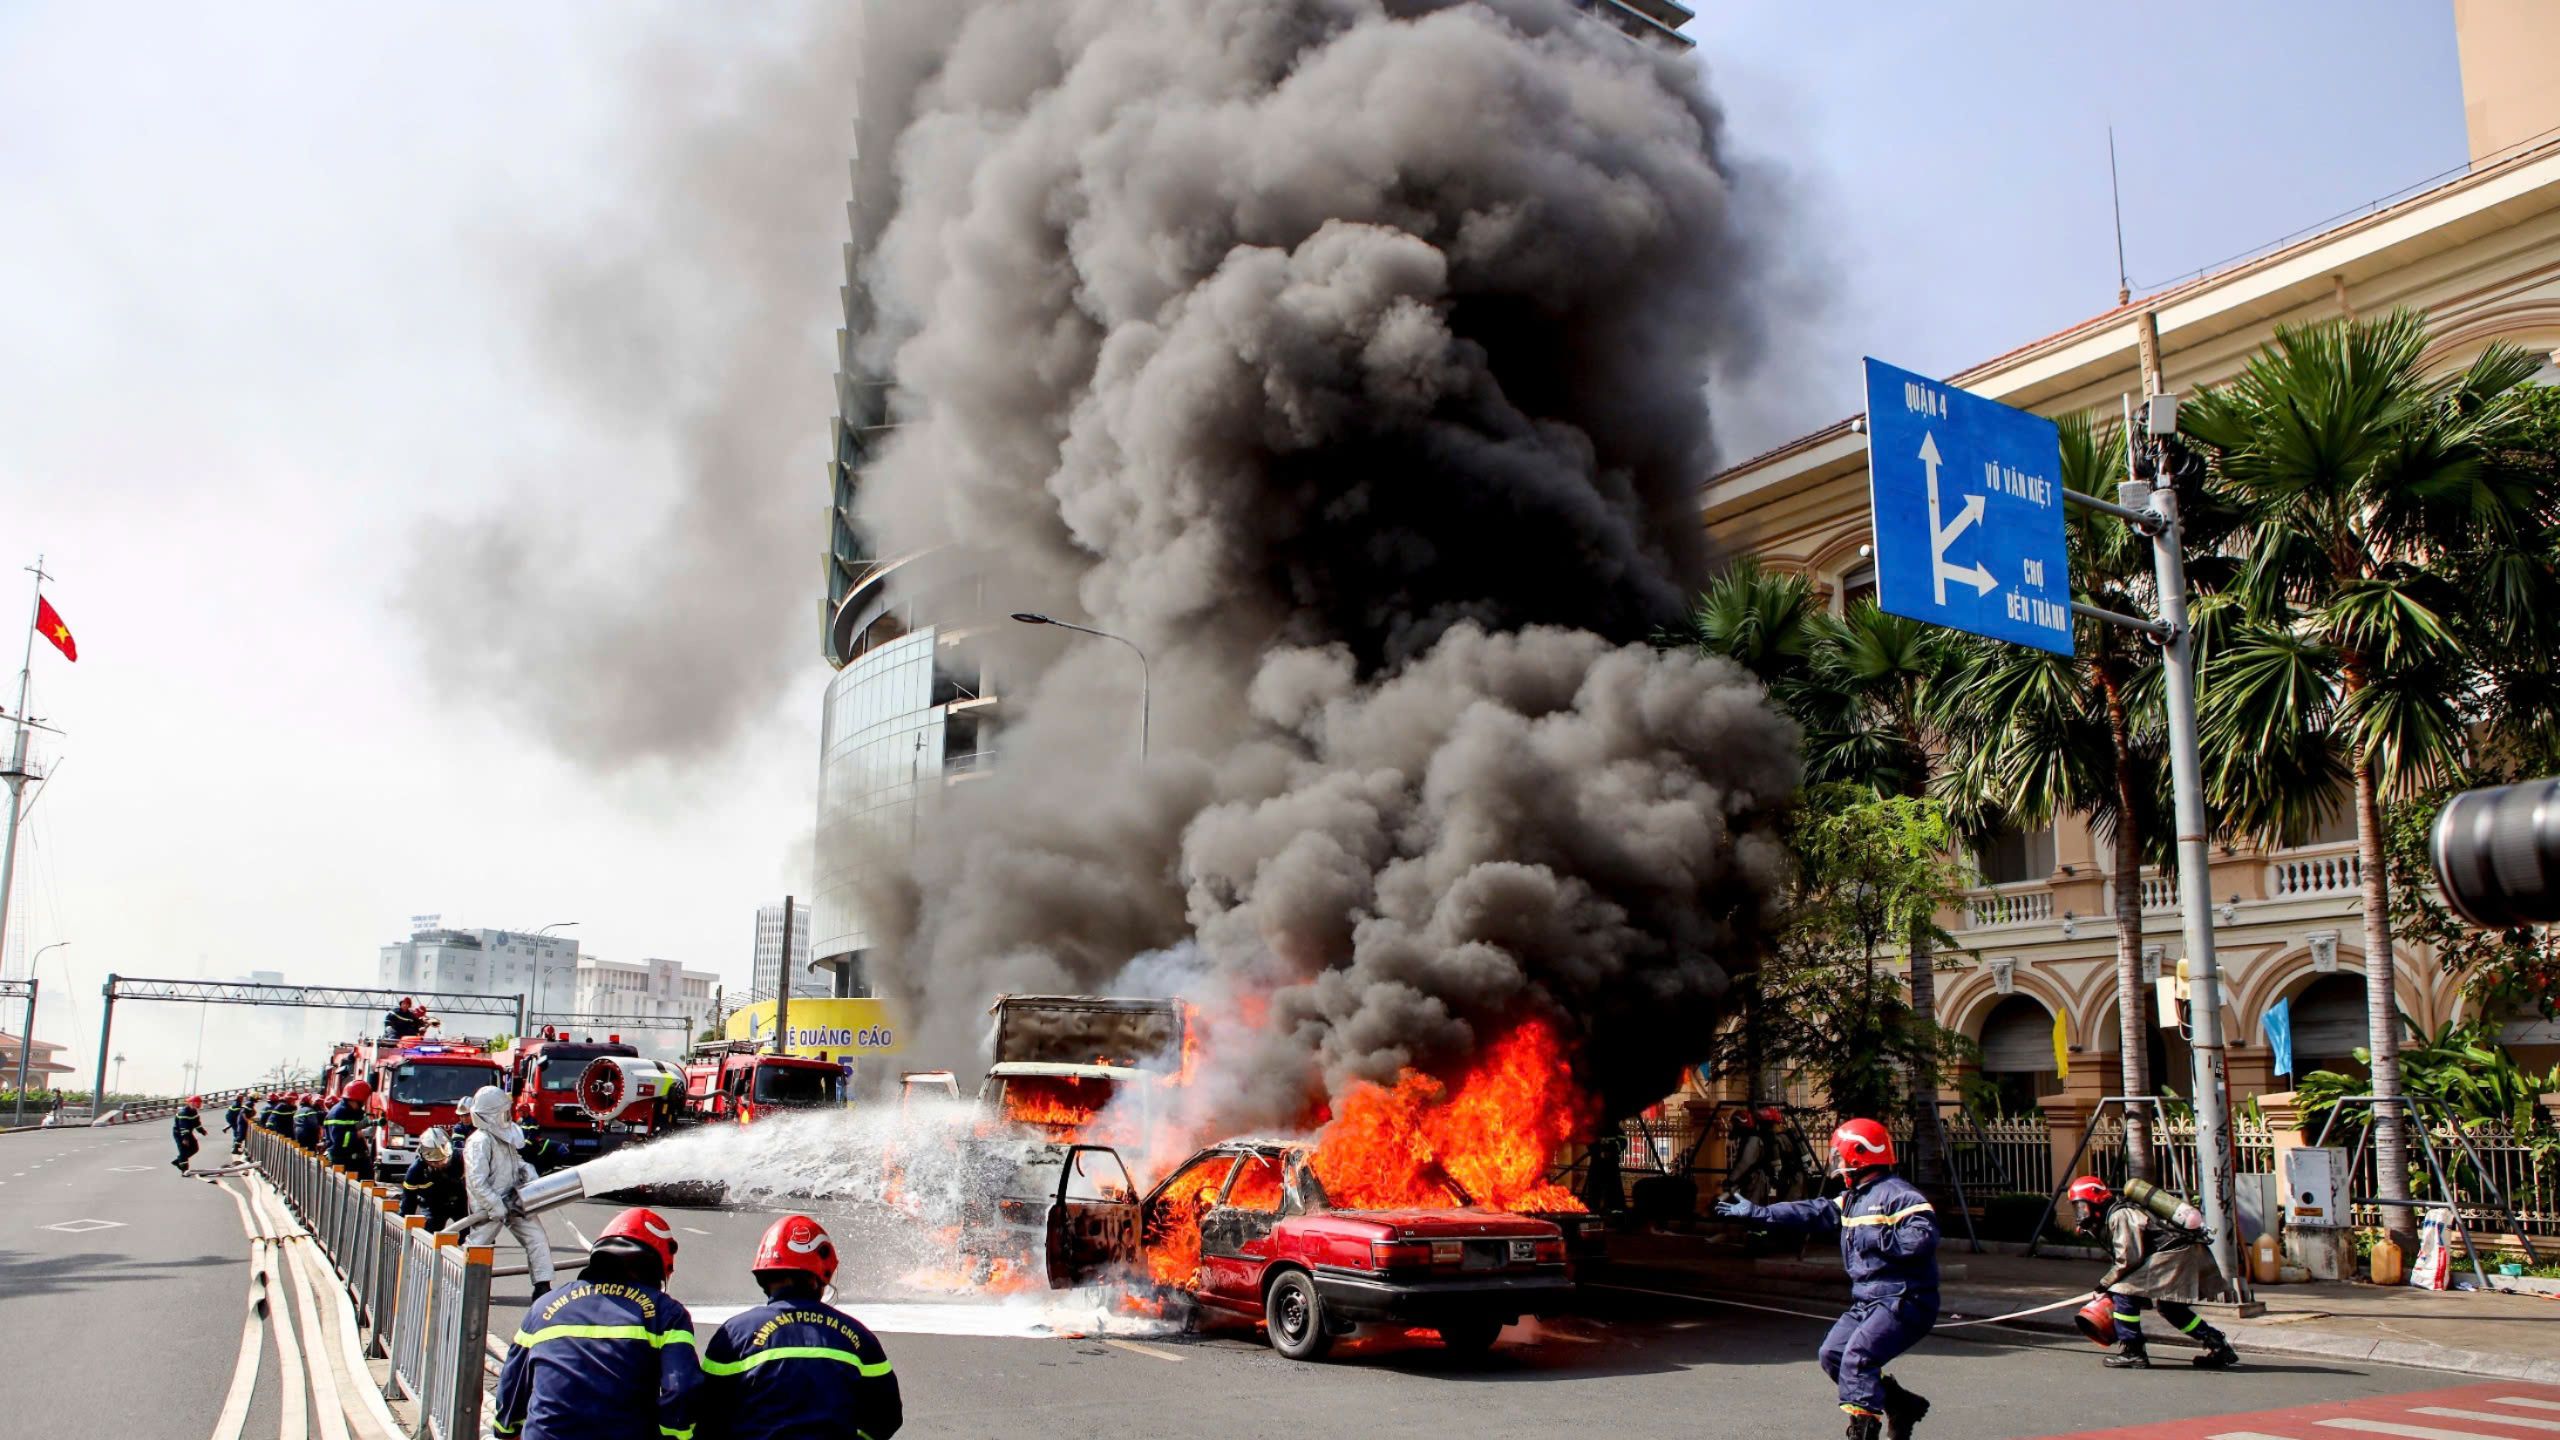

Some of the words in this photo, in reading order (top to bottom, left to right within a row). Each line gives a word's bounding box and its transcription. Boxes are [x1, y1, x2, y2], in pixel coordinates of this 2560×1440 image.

[1905, 382, 1936, 418] QUẬN
[1939, 394, 1947, 420] 4
[1985, 460, 2000, 491] VÕ
[2003, 465, 2026, 499] VĂN
[2028, 474, 2051, 509] KIỆT
[2023, 558, 2044, 592] CHỢ
[2006, 585, 2029, 623] BẾN
[2031, 598, 2066, 632] THÀNH
[800, 1025, 851, 1046] QUẢNG
[858, 1025, 892, 1046] CÁO
[594, 1283, 625, 1296] PCCC
[624, 1286, 640, 1300] VÀ
[635, 1293, 656, 1318] CNCH
[796, 1311, 823, 1324] PCCC
